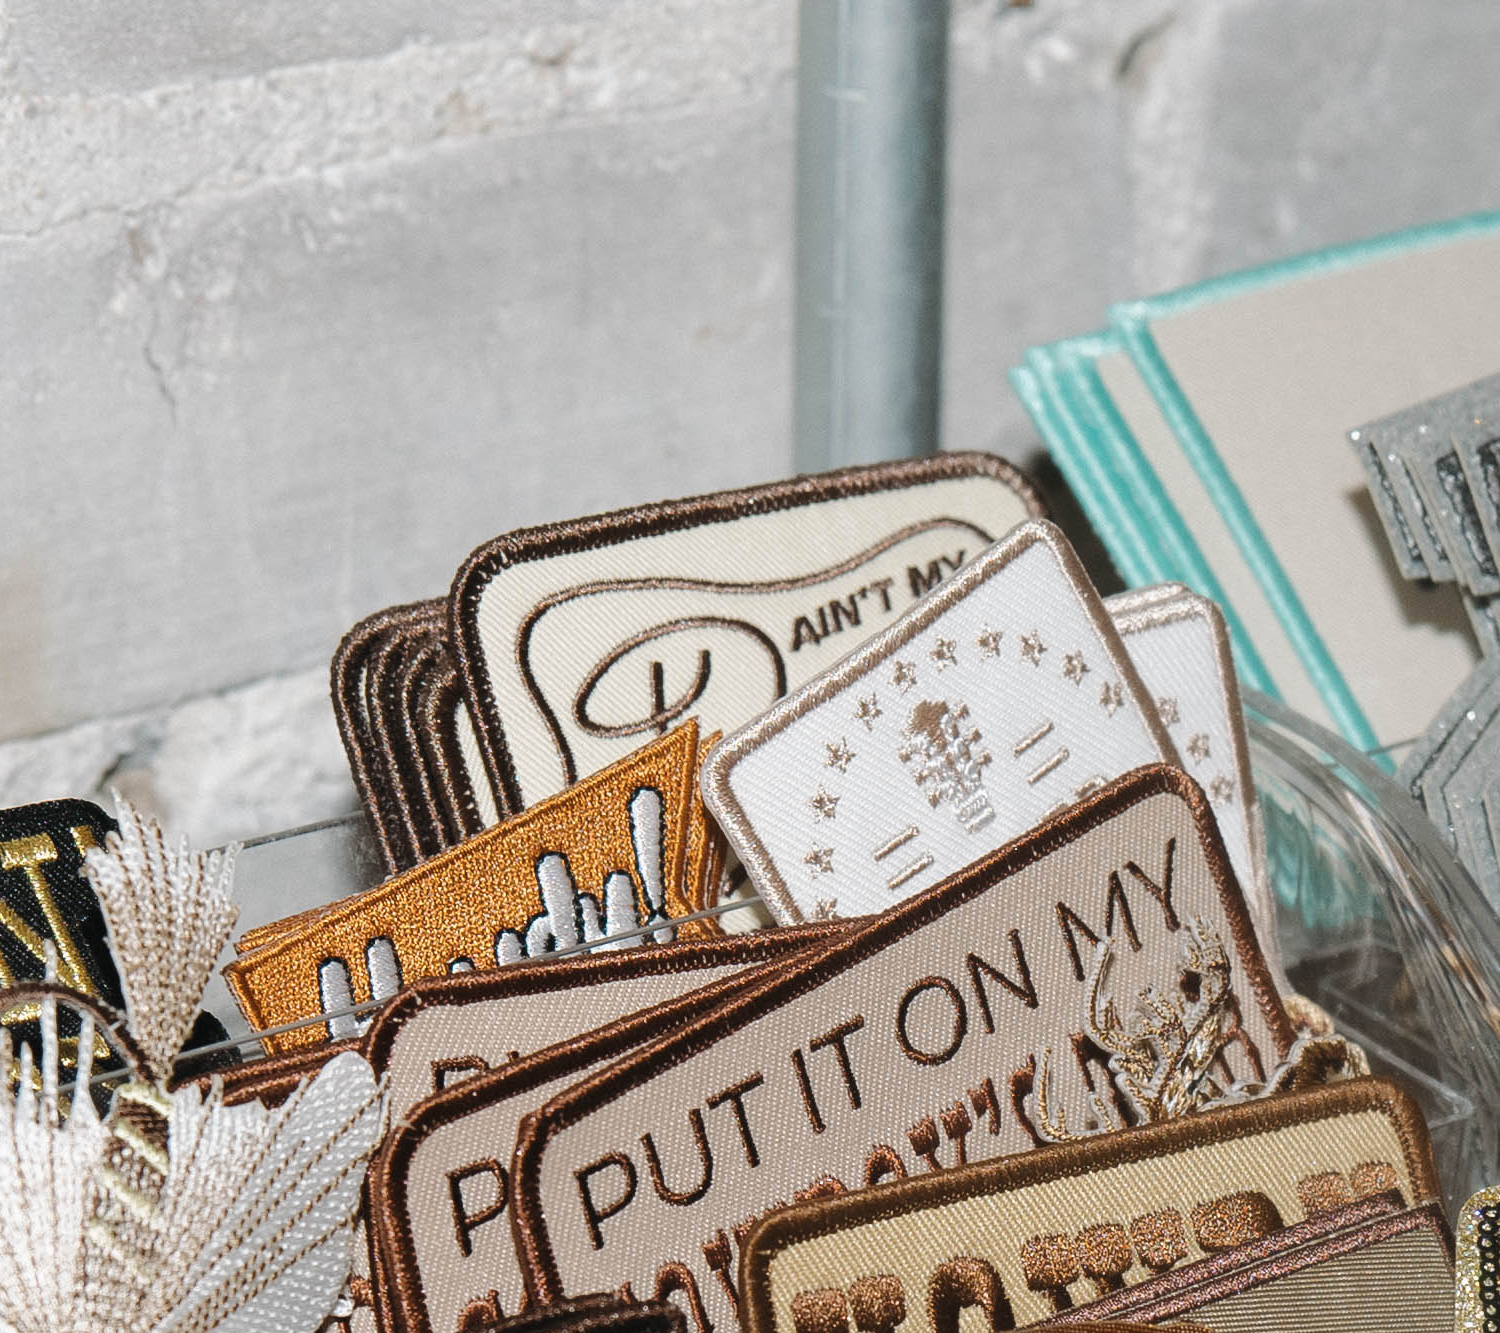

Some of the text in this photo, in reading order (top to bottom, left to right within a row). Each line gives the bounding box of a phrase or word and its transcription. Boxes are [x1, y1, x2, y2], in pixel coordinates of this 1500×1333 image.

[792, 577, 894, 651] AIN'T
[575, 1073, 767, 1251] PUT
[790, 1014, 866, 1133] IT
[898, 932, 1040, 1066] ON
[1056, 837, 1180, 982] MY
